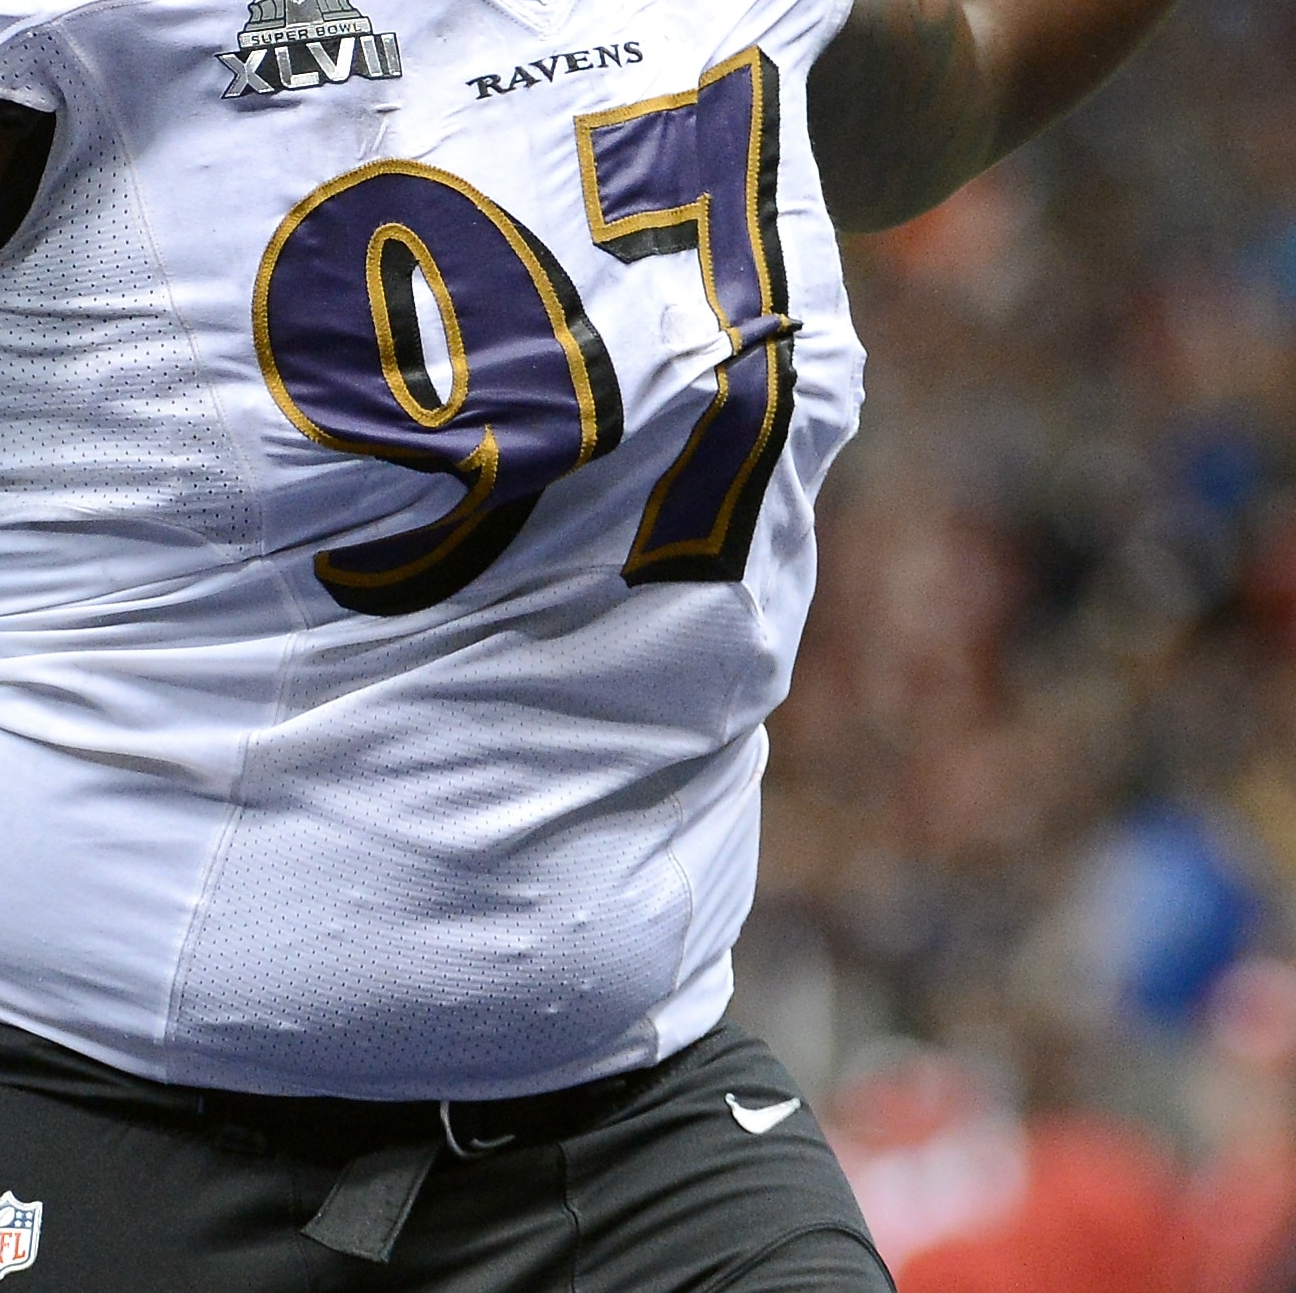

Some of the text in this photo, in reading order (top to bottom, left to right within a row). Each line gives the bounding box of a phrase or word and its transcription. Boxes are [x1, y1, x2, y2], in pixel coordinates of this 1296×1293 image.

[251, 21, 363, 45] SUPER BOWL
[215, 32, 403, 99] XLVII
[465, 41, 643, 100] RAVENS
[252, 44, 797, 616] 97
